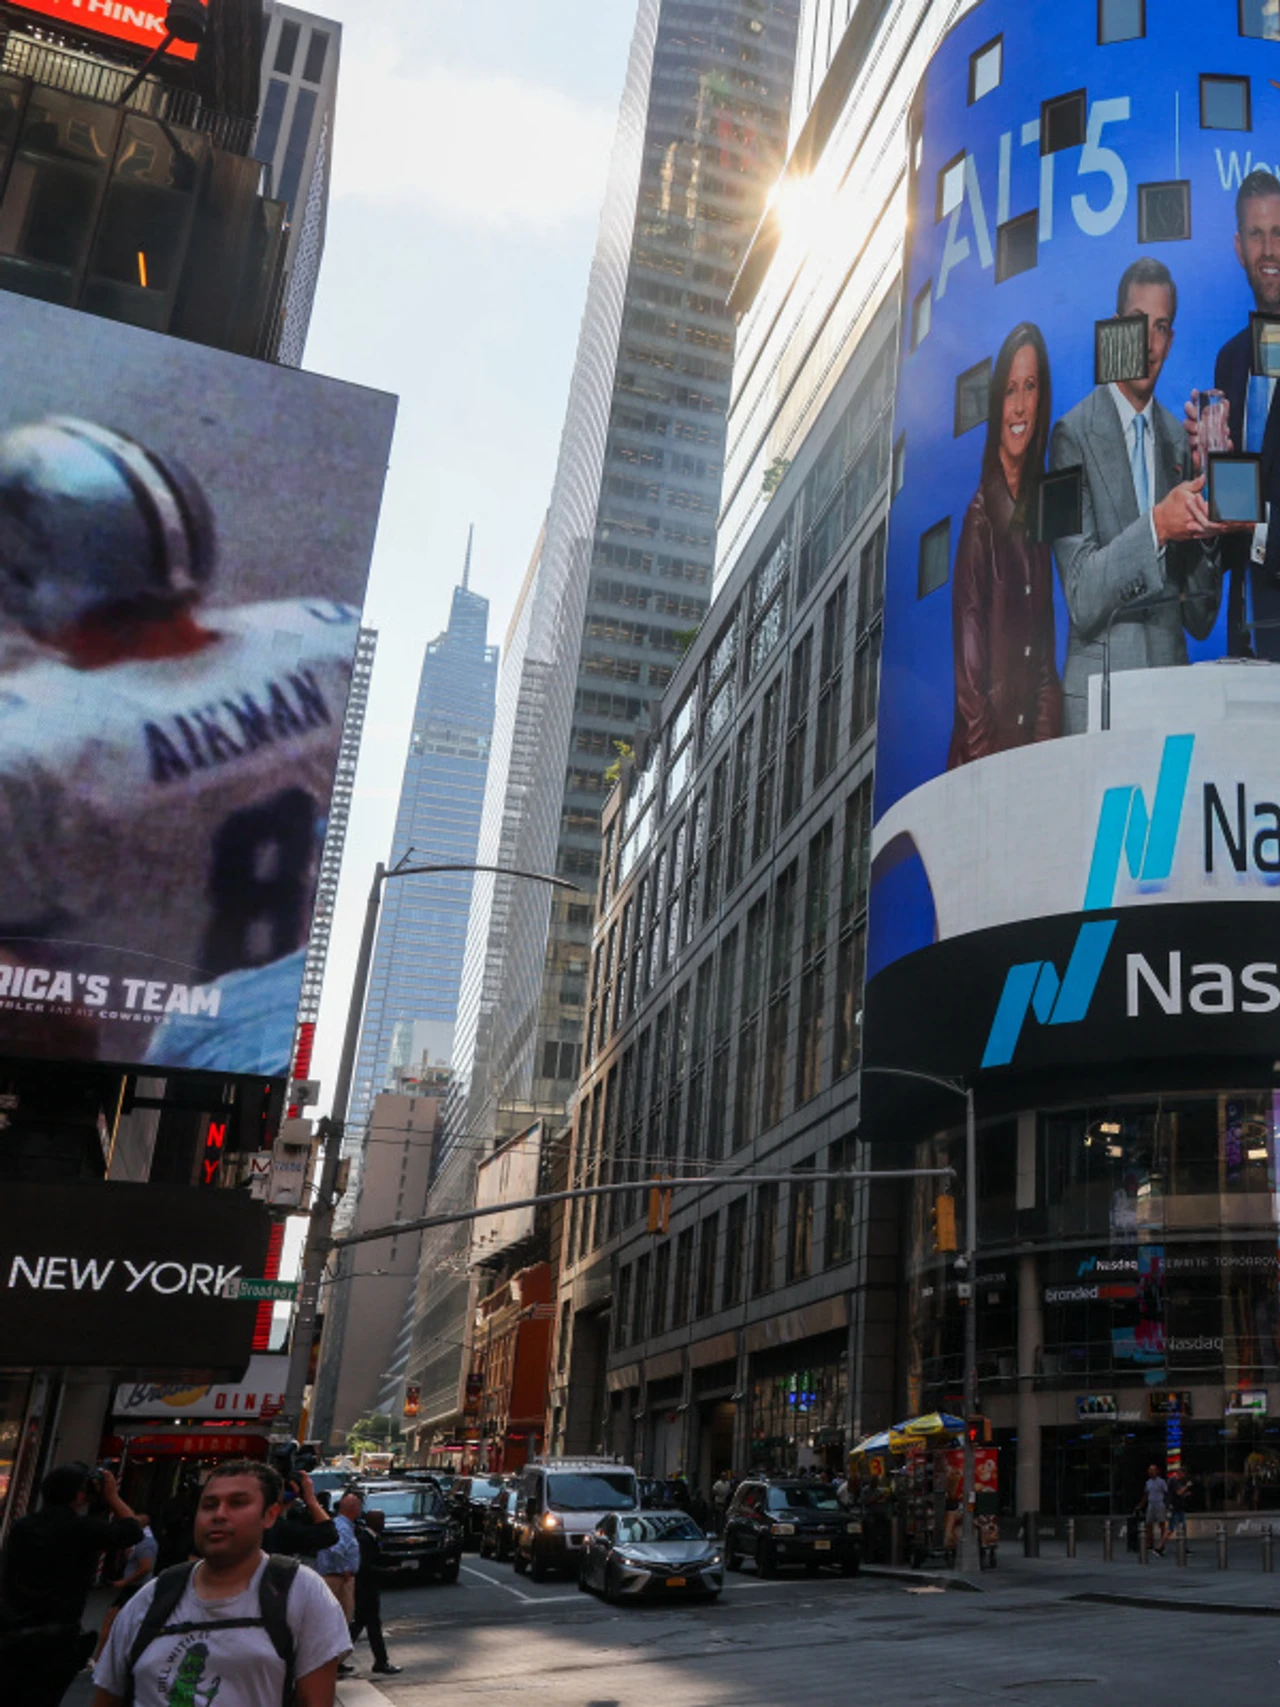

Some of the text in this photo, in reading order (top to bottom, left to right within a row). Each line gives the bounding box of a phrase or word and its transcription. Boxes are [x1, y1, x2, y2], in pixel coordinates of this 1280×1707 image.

[121, 977, 222, 1018] TEAM
[8, 1256, 114, 1291] NEW
[123, 1260, 242, 1297] YORK
[1096, 1259, 1138, 1272] Nasdaq
[241, 1281, 294, 1300] Broadway
